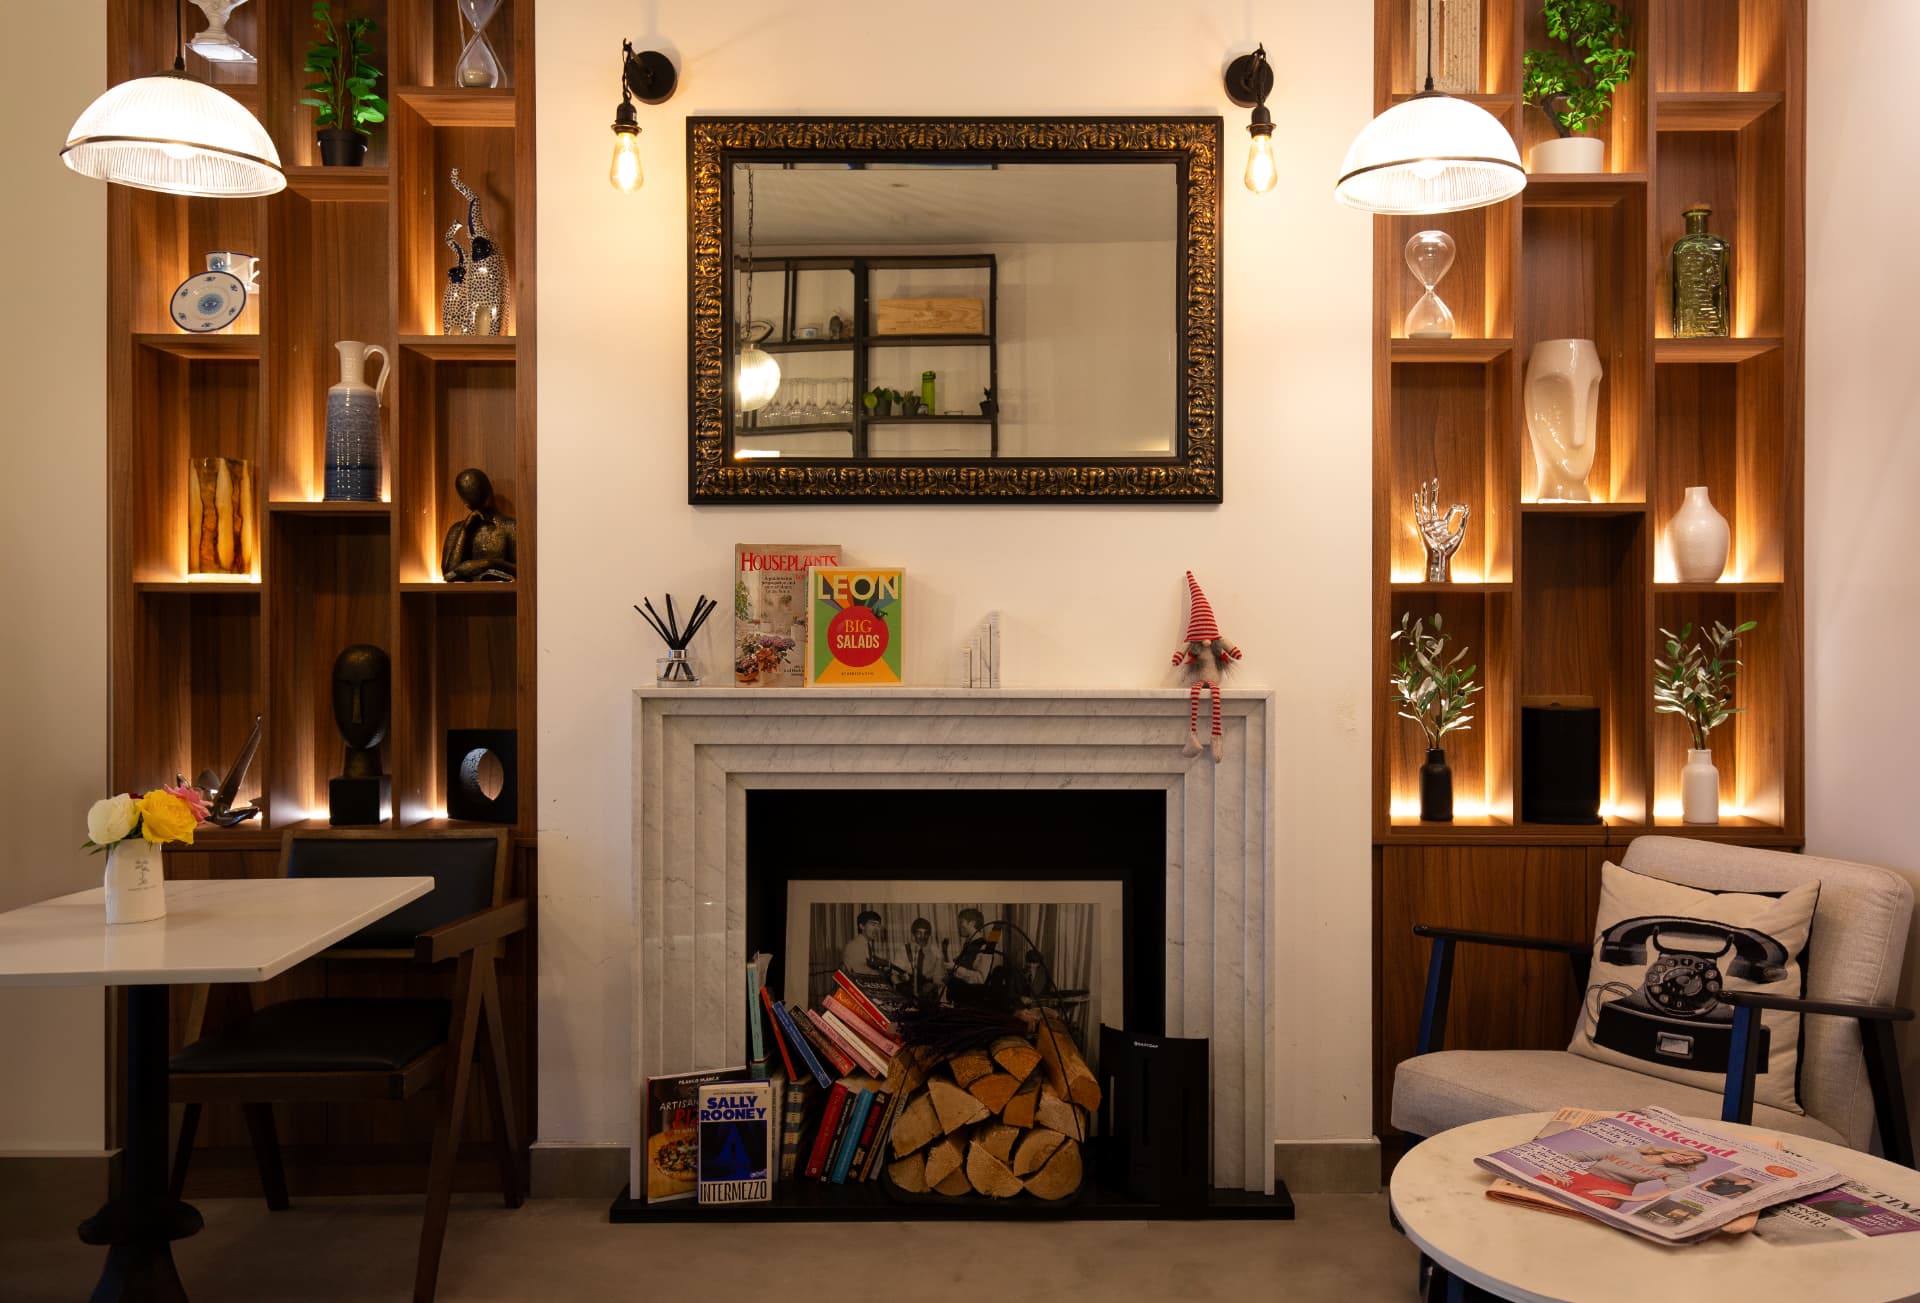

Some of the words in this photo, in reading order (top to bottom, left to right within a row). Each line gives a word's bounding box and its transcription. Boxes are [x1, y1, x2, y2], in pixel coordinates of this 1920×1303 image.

[740, 552, 839, 571] HOUSEPLANTS
[818, 574, 899, 600] LEON
[845, 619, 872, 633] BIG
[837, 634, 880, 649] SALADS
[707, 1095, 759, 1109] SALLY
[701, 1108, 767, 1121] ROONEY
[1616, 1112, 1738, 1158] Weekend
[701, 1180, 767, 1202] INTERMEZZO
